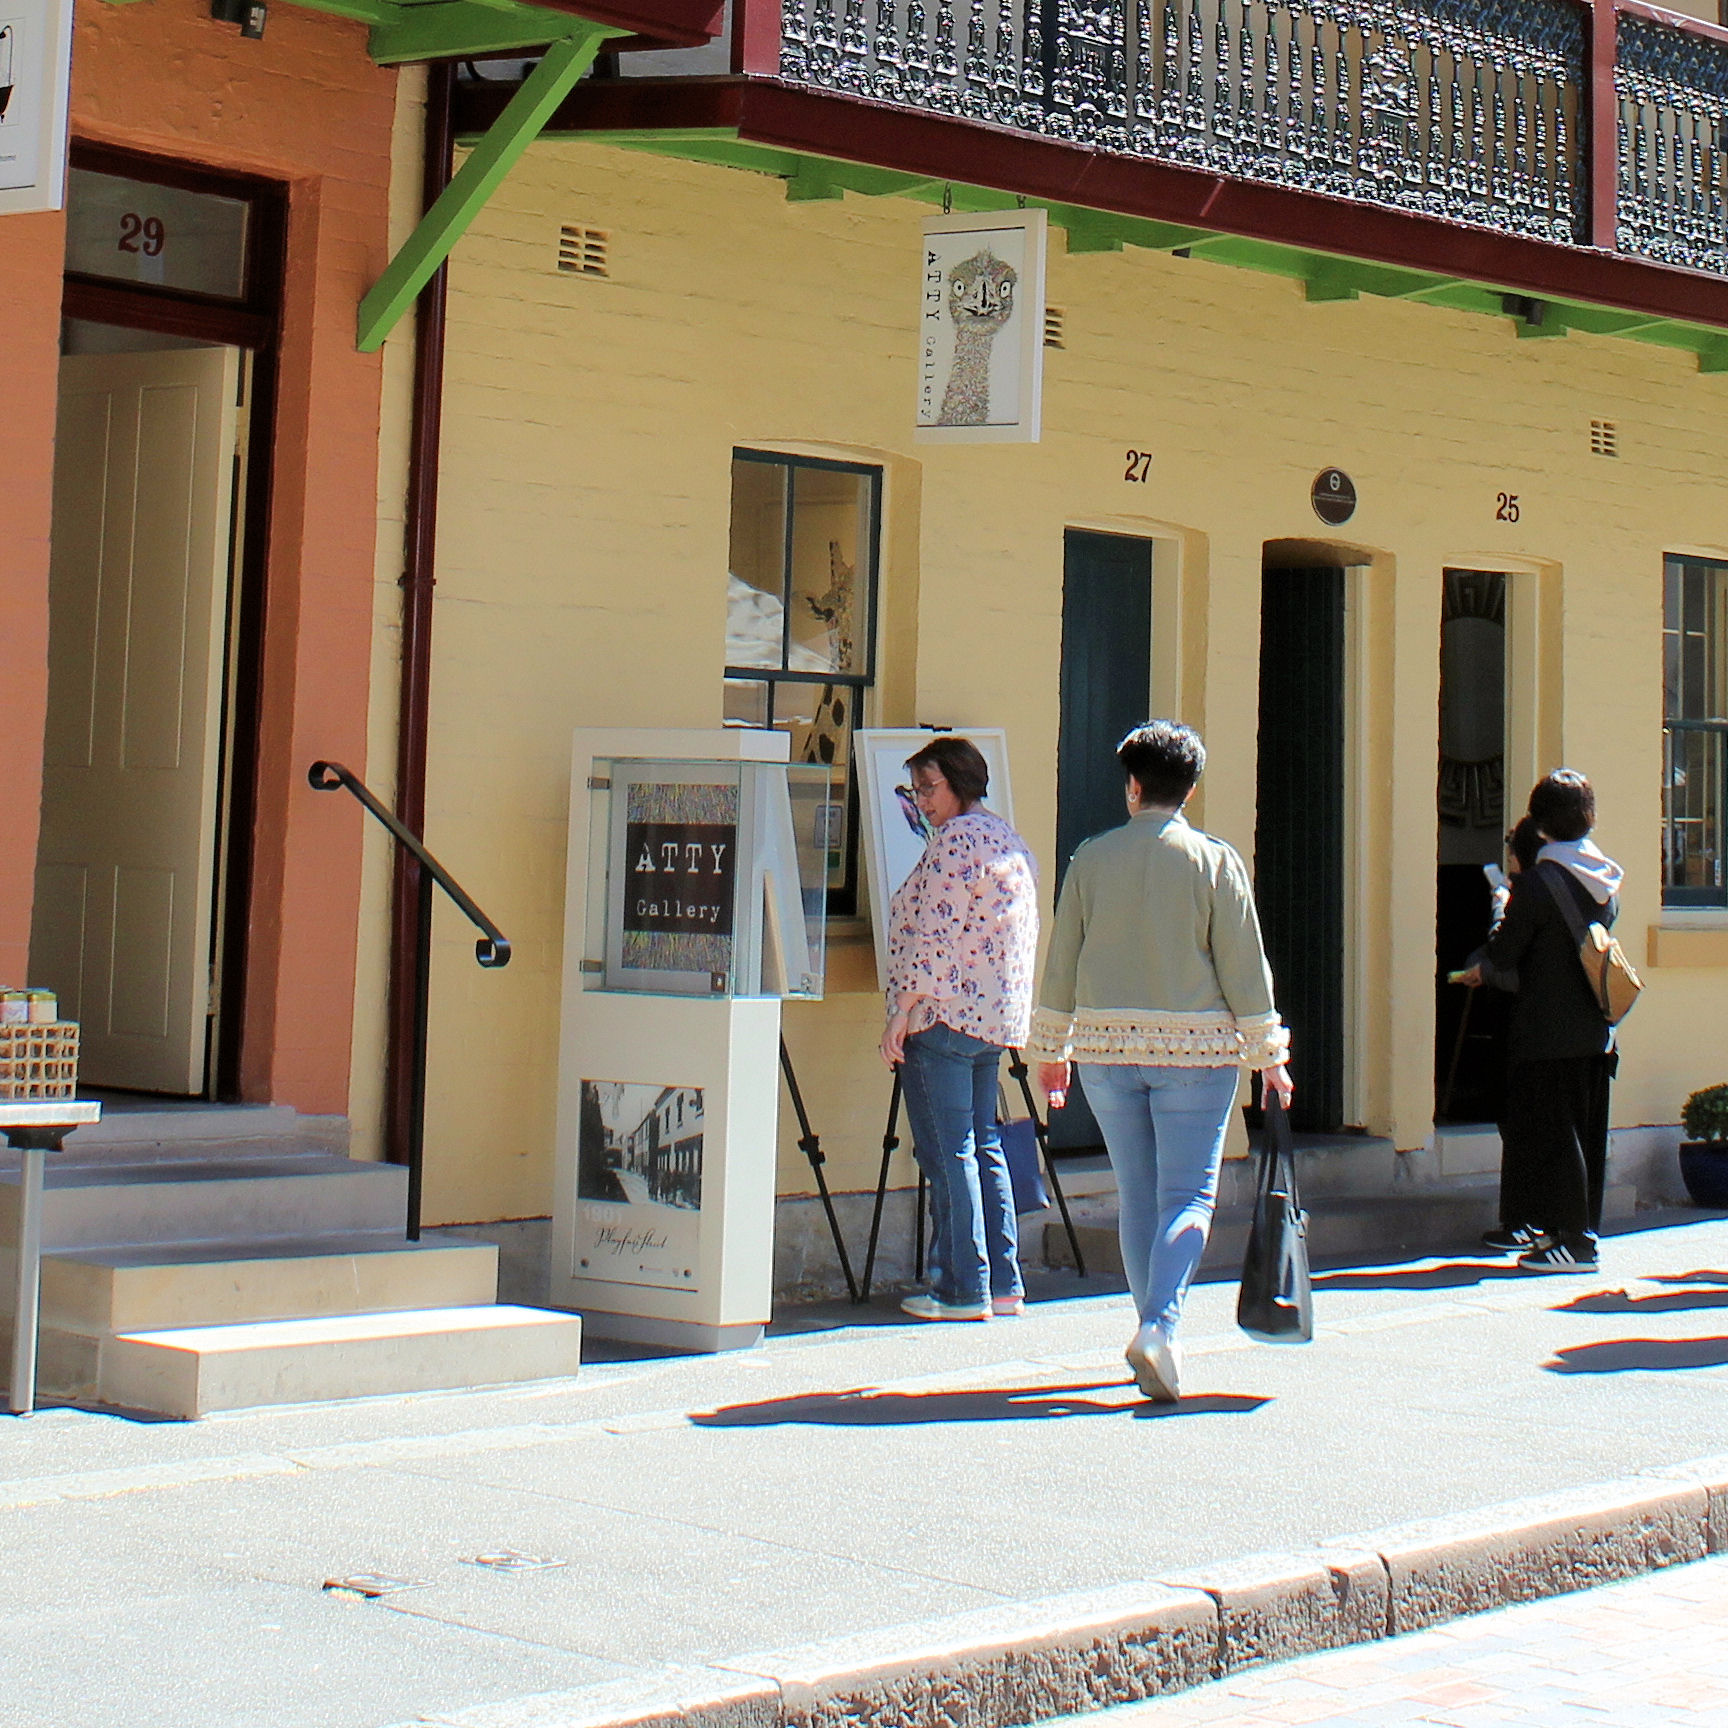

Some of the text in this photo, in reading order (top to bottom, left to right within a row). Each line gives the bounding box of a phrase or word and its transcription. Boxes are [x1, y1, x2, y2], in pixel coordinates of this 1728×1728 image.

[118, 213, 165, 257] 29
[926, 251, 942, 321] ATTY
[1123, 449, 1153, 484] 27
[1495, 491, 1521, 524] 25
[635, 841, 728, 876] ATTY
[637, 898, 721, 926] Gallery
